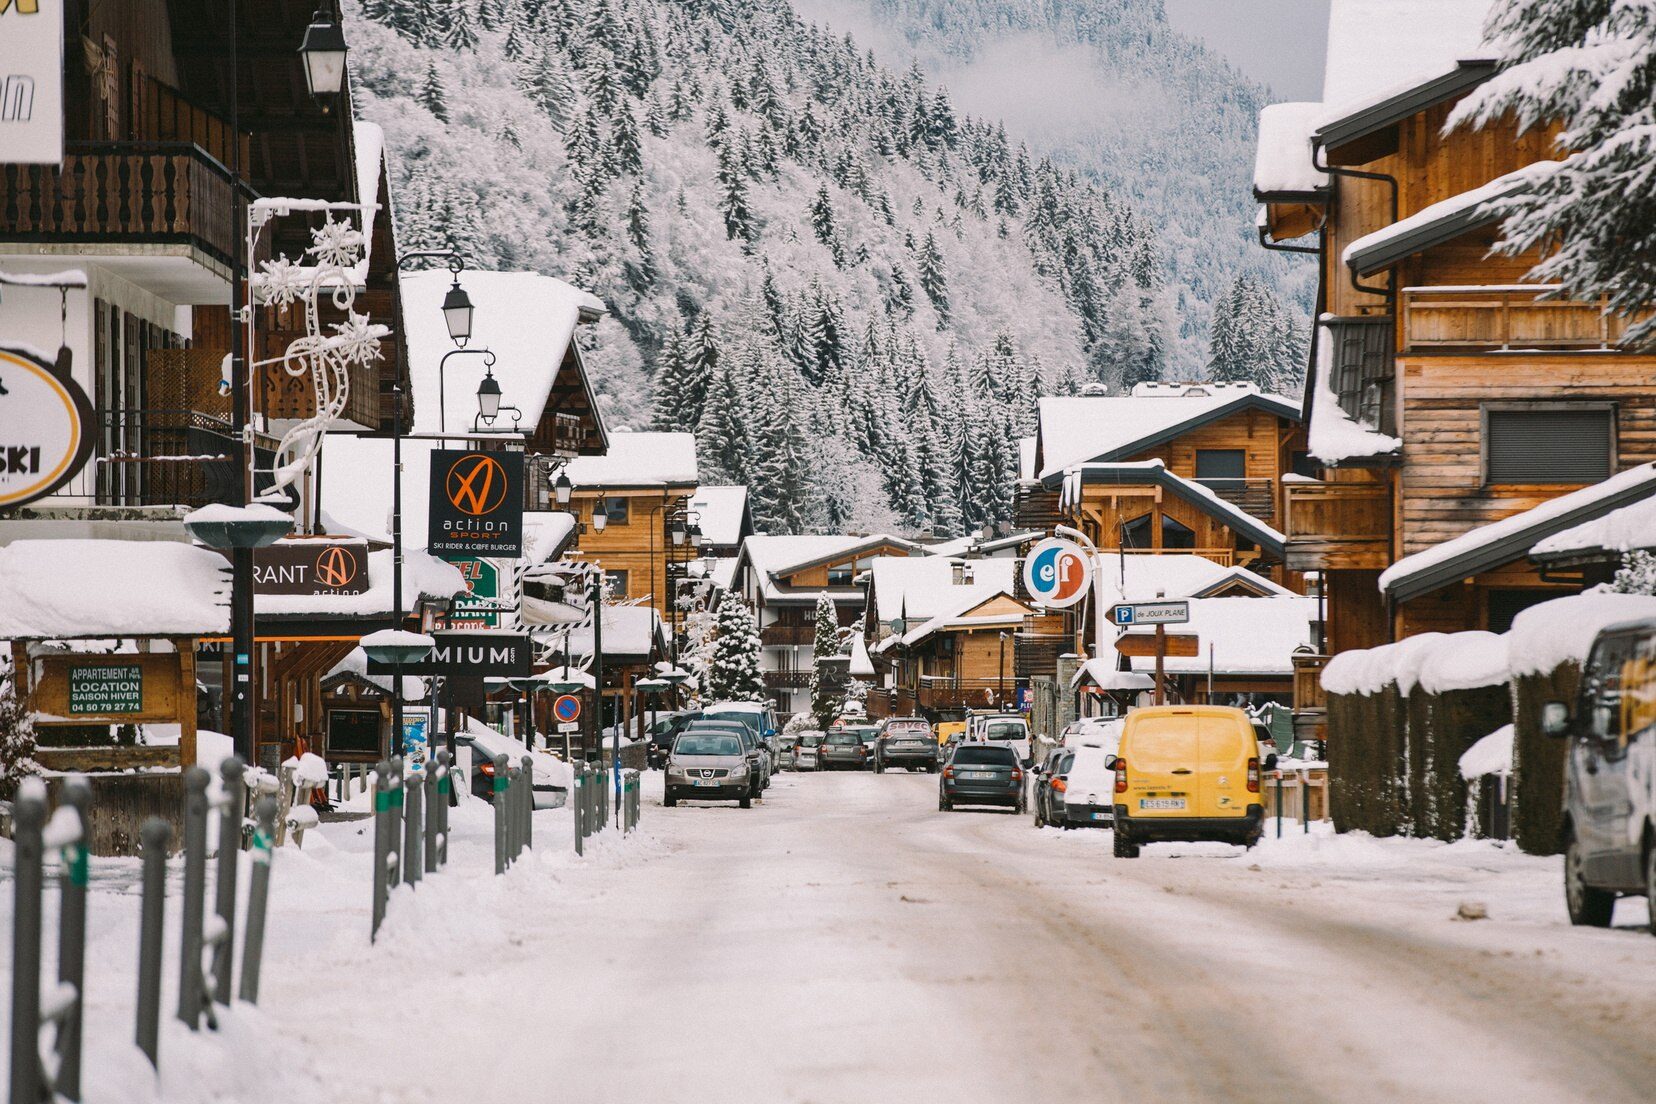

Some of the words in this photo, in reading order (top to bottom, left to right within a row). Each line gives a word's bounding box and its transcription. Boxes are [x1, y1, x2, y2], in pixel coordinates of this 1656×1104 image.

[443, 518, 508, 531] action
[1121, 609, 1129, 621] P
[1146, 610, 1164, 618] JOUX
[1165, 608, 1185, 617] PLANE
[430, 646, 509, 664] MIUM
[72, 668, 128, 680] APPARTEMENT
[72, 682, 139, 692] LOCATION
[72, 693, 108, 701] SAISON
[110, 692, 139, 700] HIVER
[100, 703, 112, 711] 79
